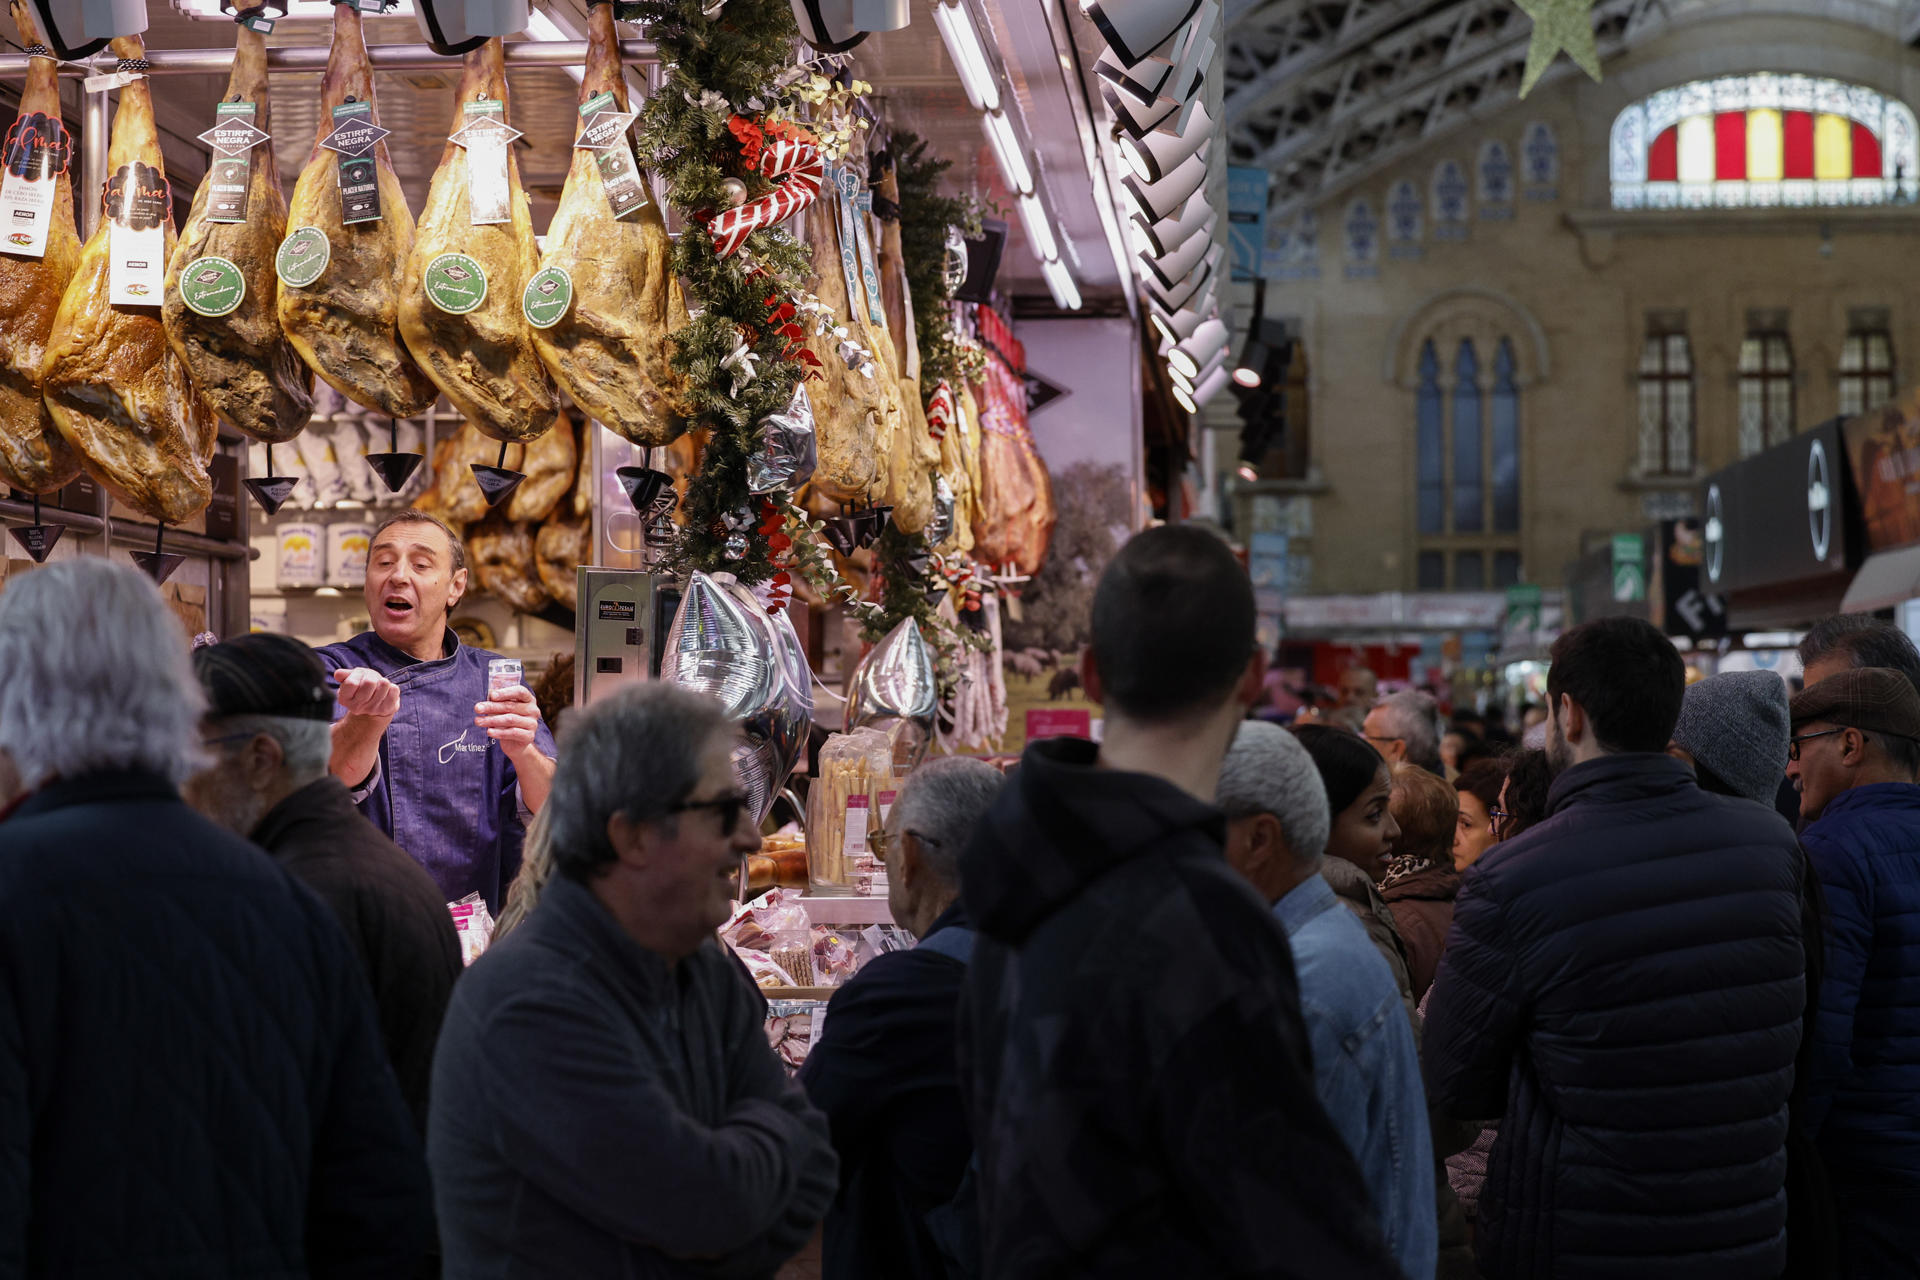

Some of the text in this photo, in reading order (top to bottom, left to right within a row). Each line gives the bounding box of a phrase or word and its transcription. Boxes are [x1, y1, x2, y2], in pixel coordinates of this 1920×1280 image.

[464, 128, 506, 137] ESTIRPE
[586, 115, 622, 138] ESTIRPE
[334, 128, 374, 141] ESTIRPE
[591, 125, 621, 144] NEGRA
[337, 136, 371, 147] NEGRA
[455, 742, 486, 752] Martínez
